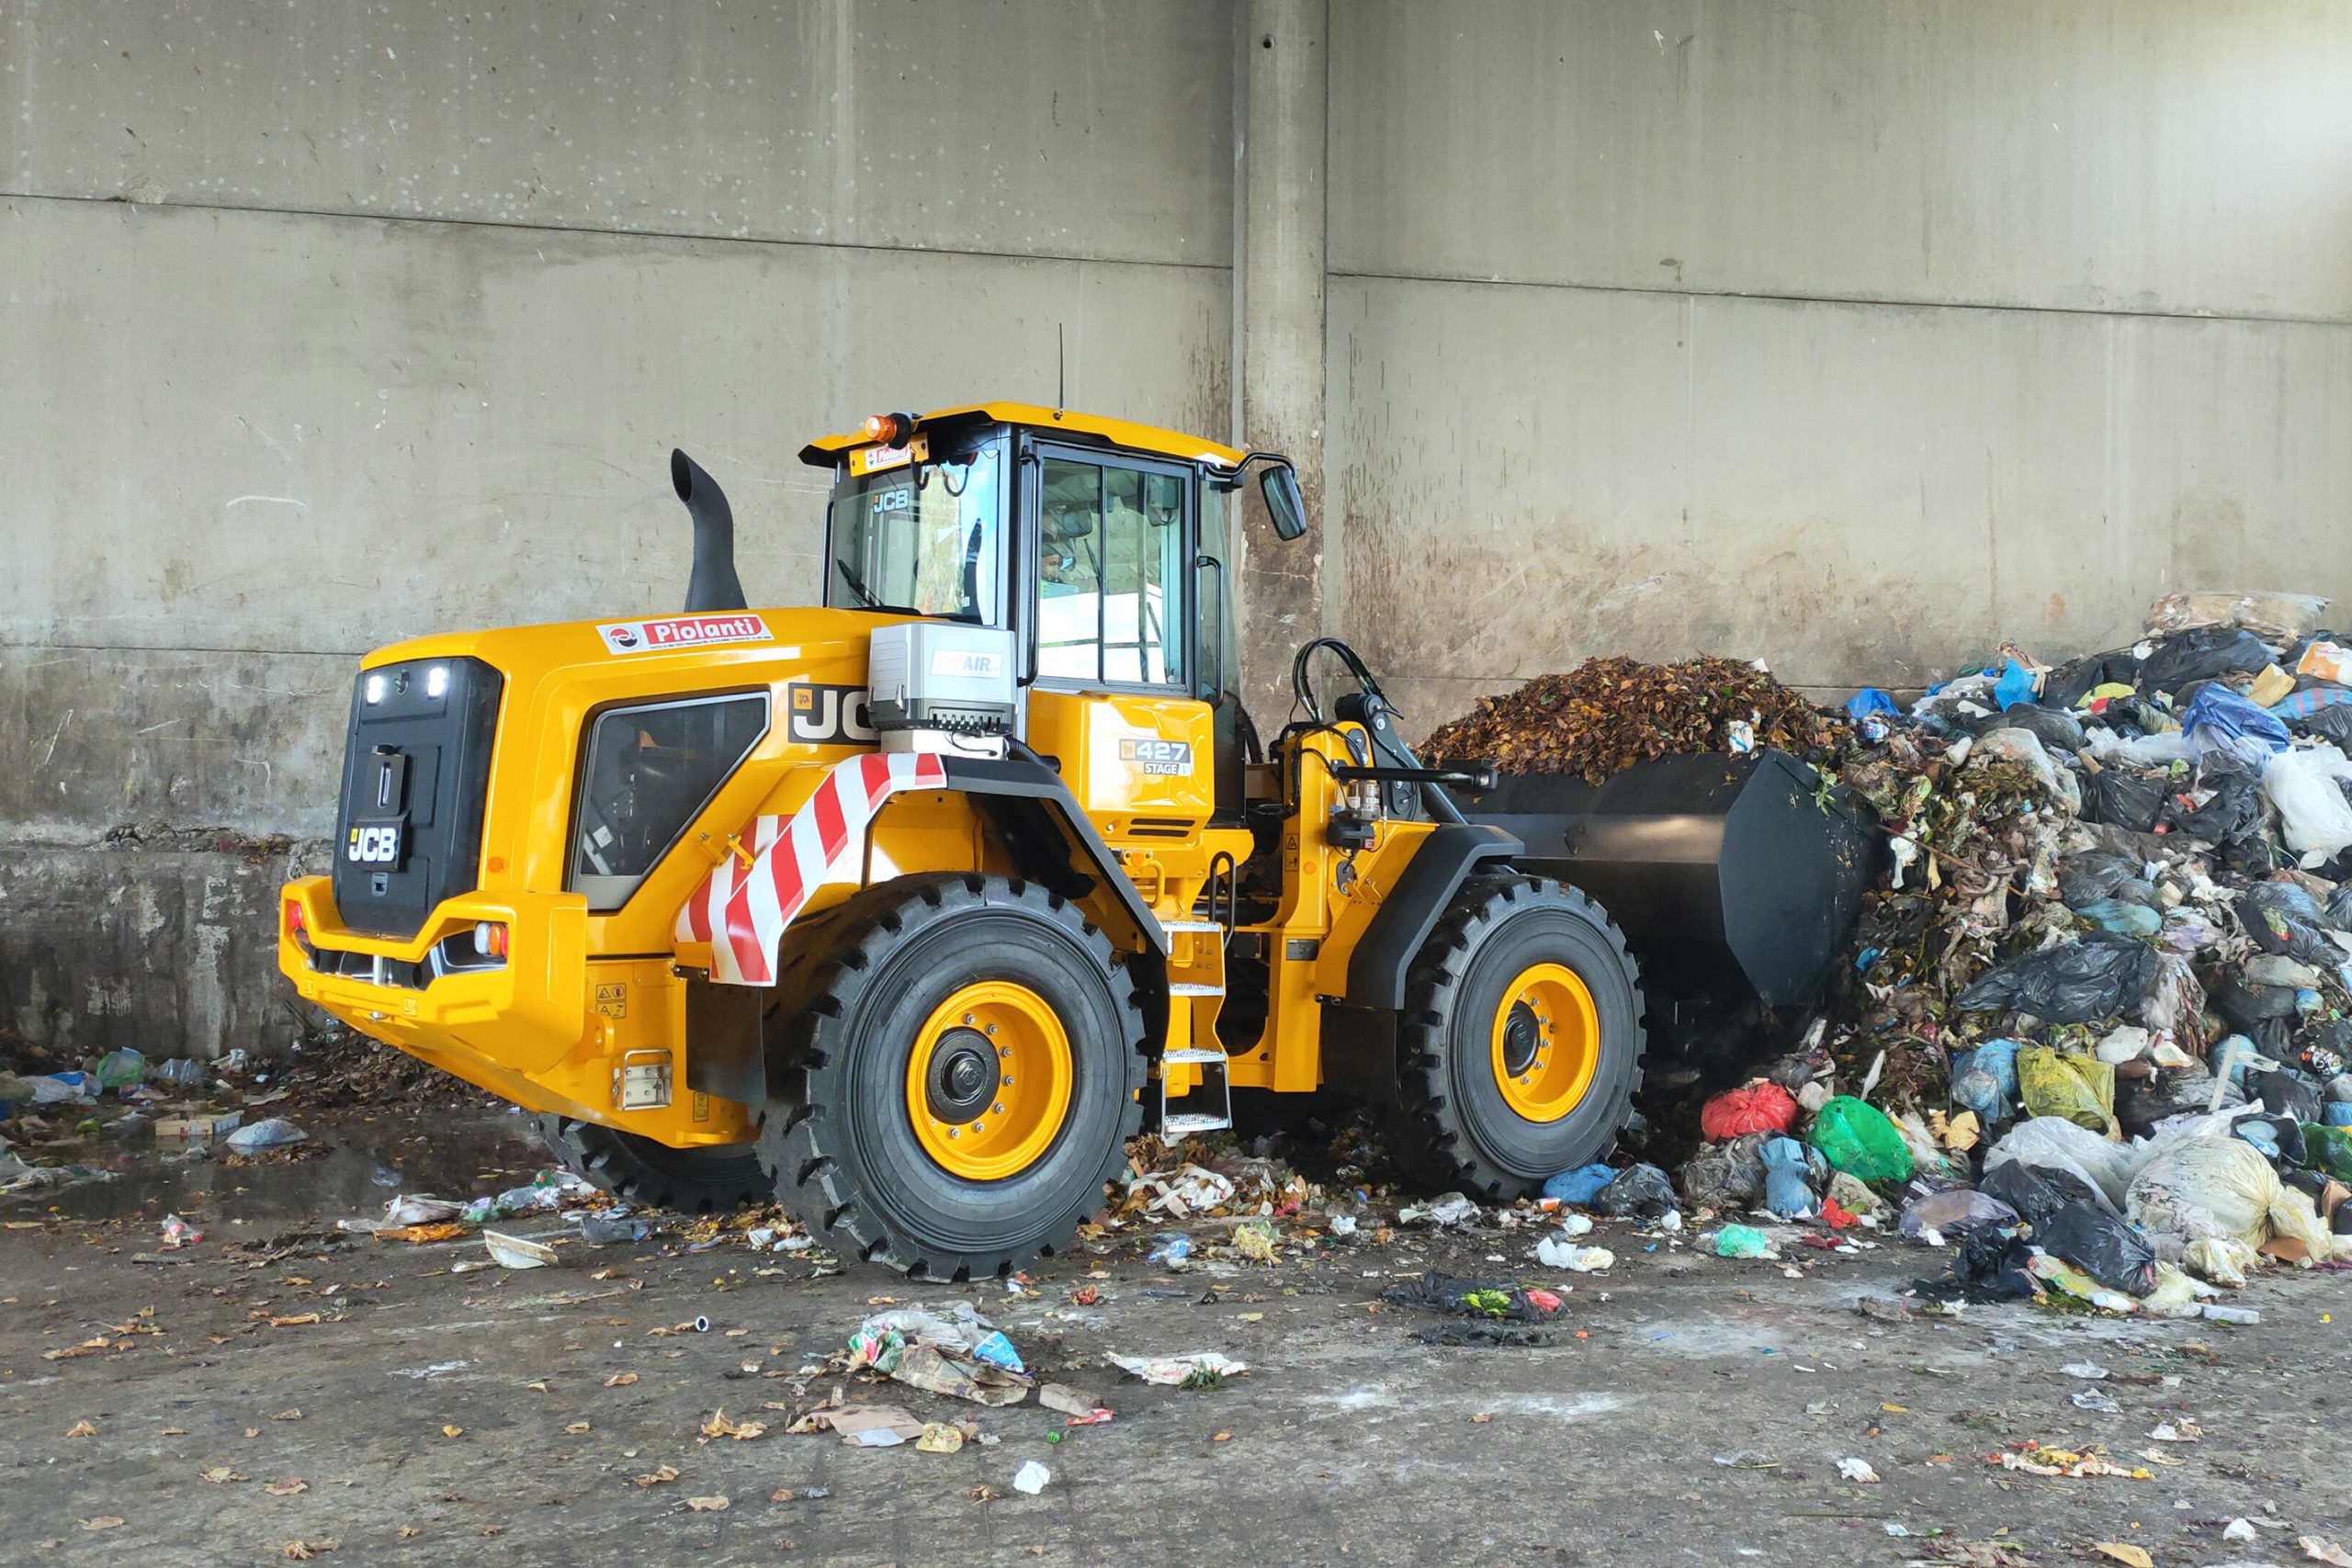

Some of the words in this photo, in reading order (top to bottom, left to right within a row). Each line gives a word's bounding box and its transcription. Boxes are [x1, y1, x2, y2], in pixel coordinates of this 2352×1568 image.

[874, 490, 909, 513] JCB
[654, 618, 755, 643] Piolanti
[1136, 741, 1187, 761] 427
[1145, 762, 1178, 774] STAGE
[349, 828, 396, 862] JCB
